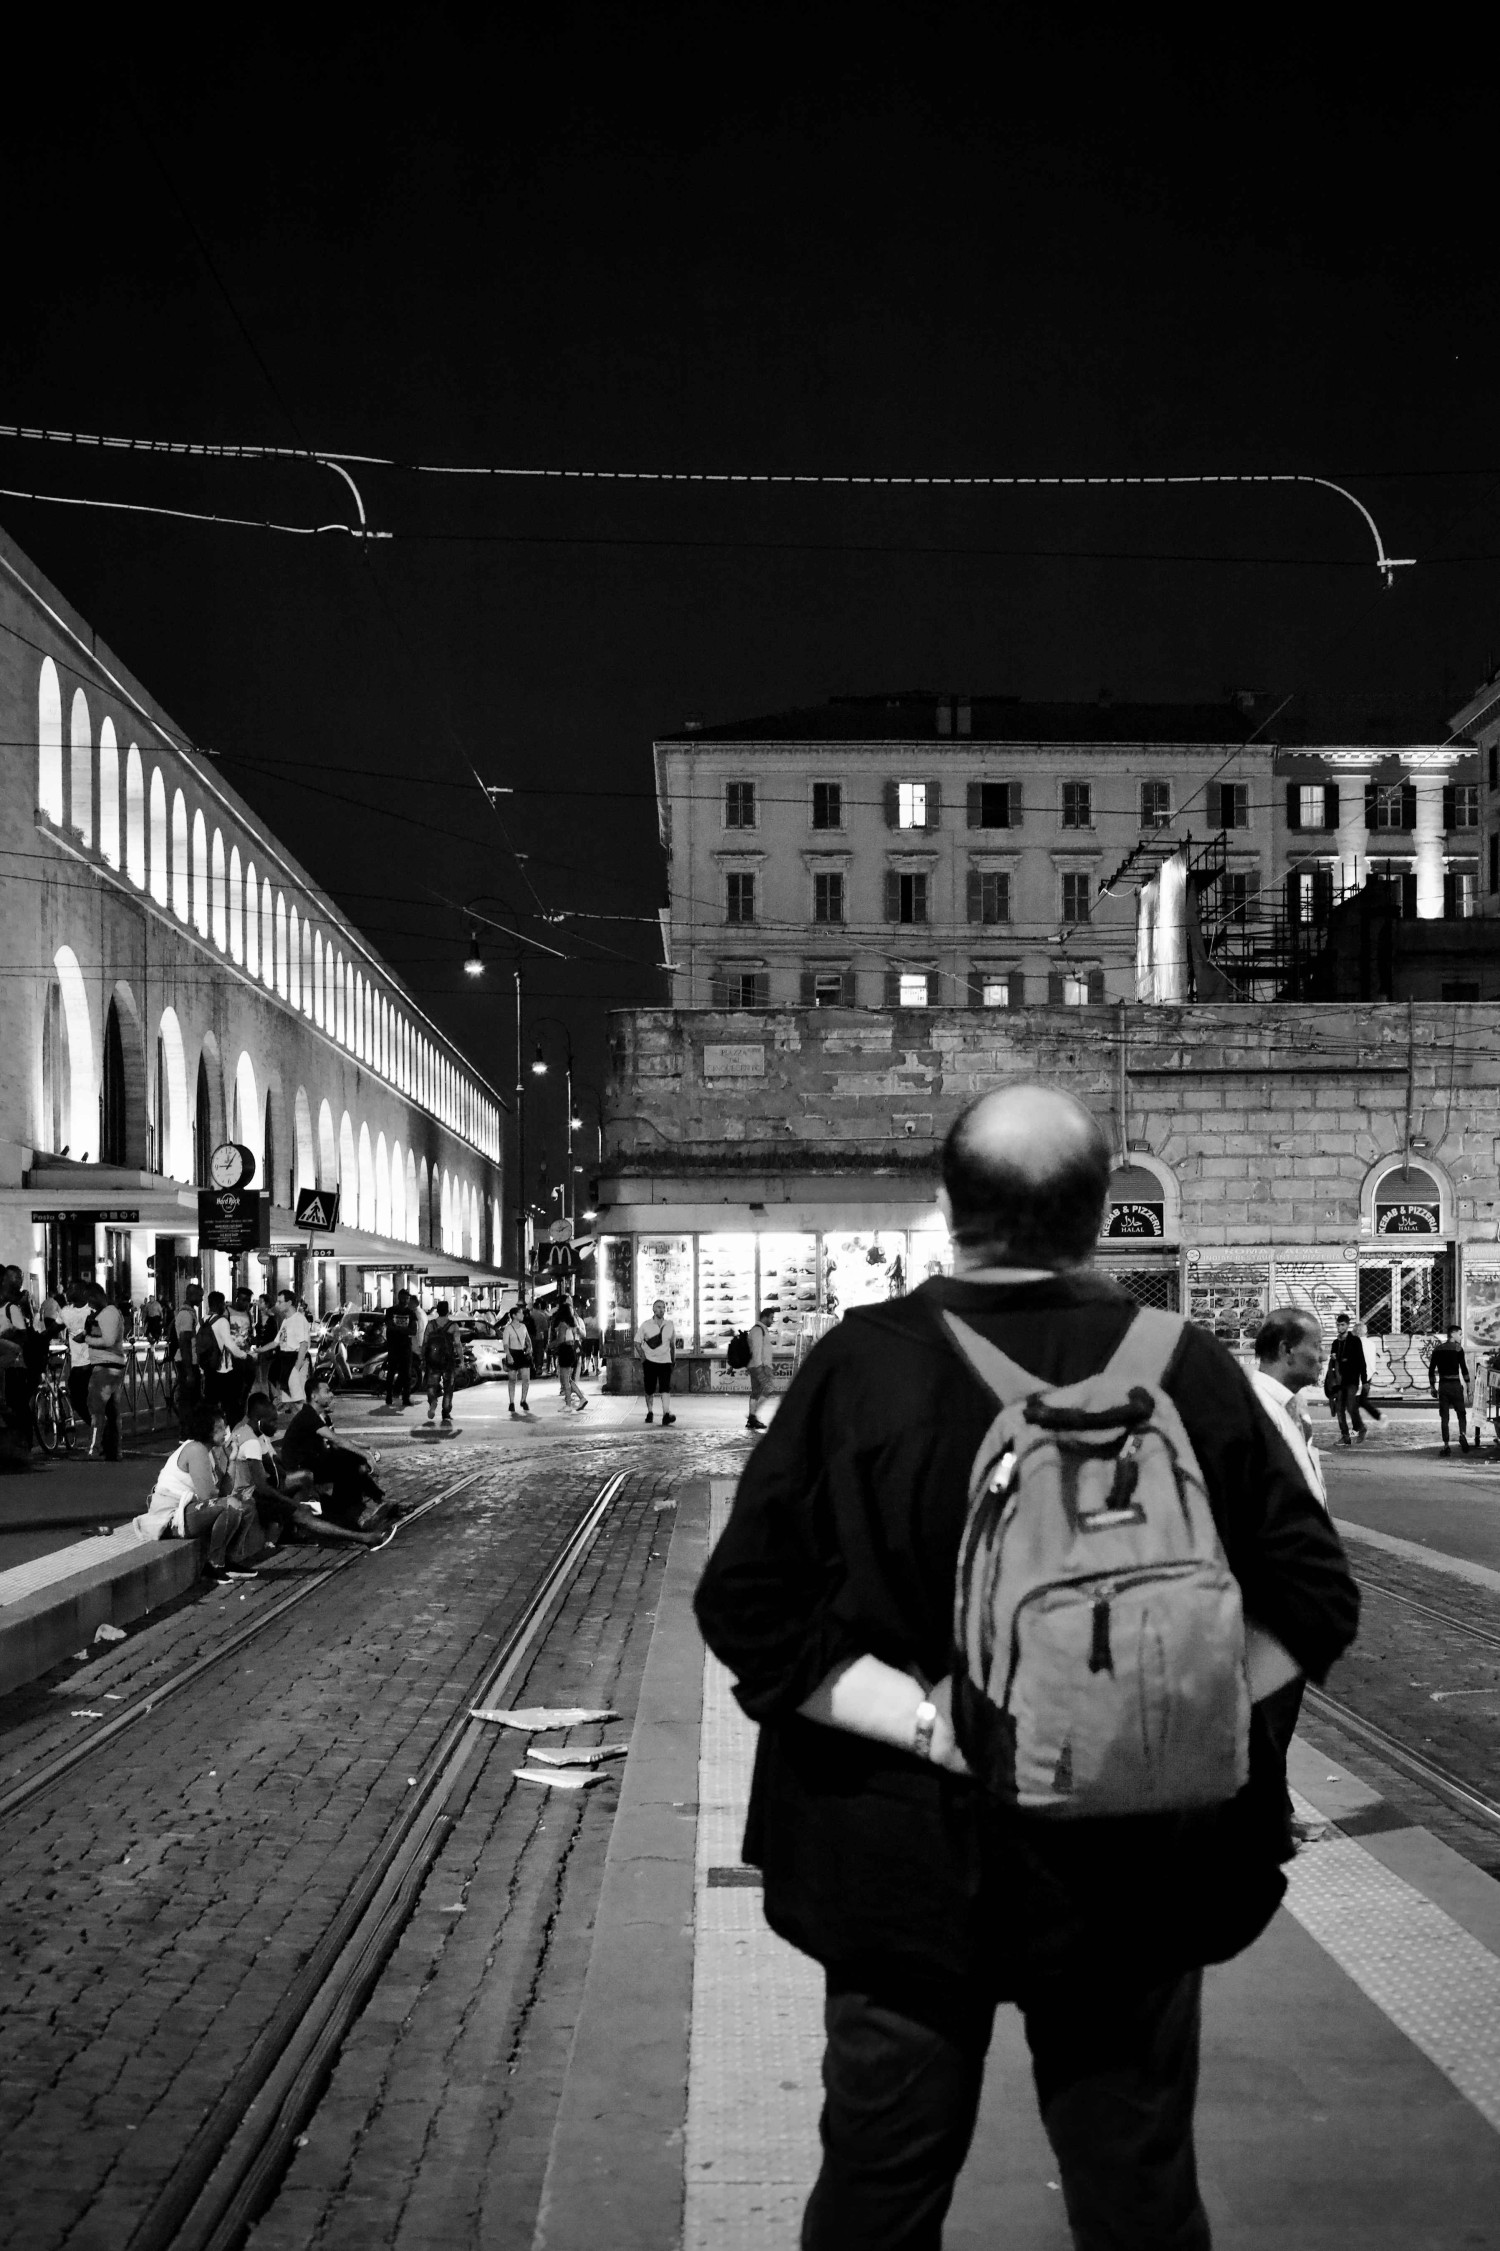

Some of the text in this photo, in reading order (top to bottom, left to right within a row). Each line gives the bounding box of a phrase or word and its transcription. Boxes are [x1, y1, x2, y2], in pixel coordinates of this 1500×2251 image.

[216, 1197, 241, 1207] Hard Rock
[1102, 1205, 1162, 1236] KEBAB & PIZZERIA
[1378, 1205, 1438, 1233] KEBAB & PIZZERIA
